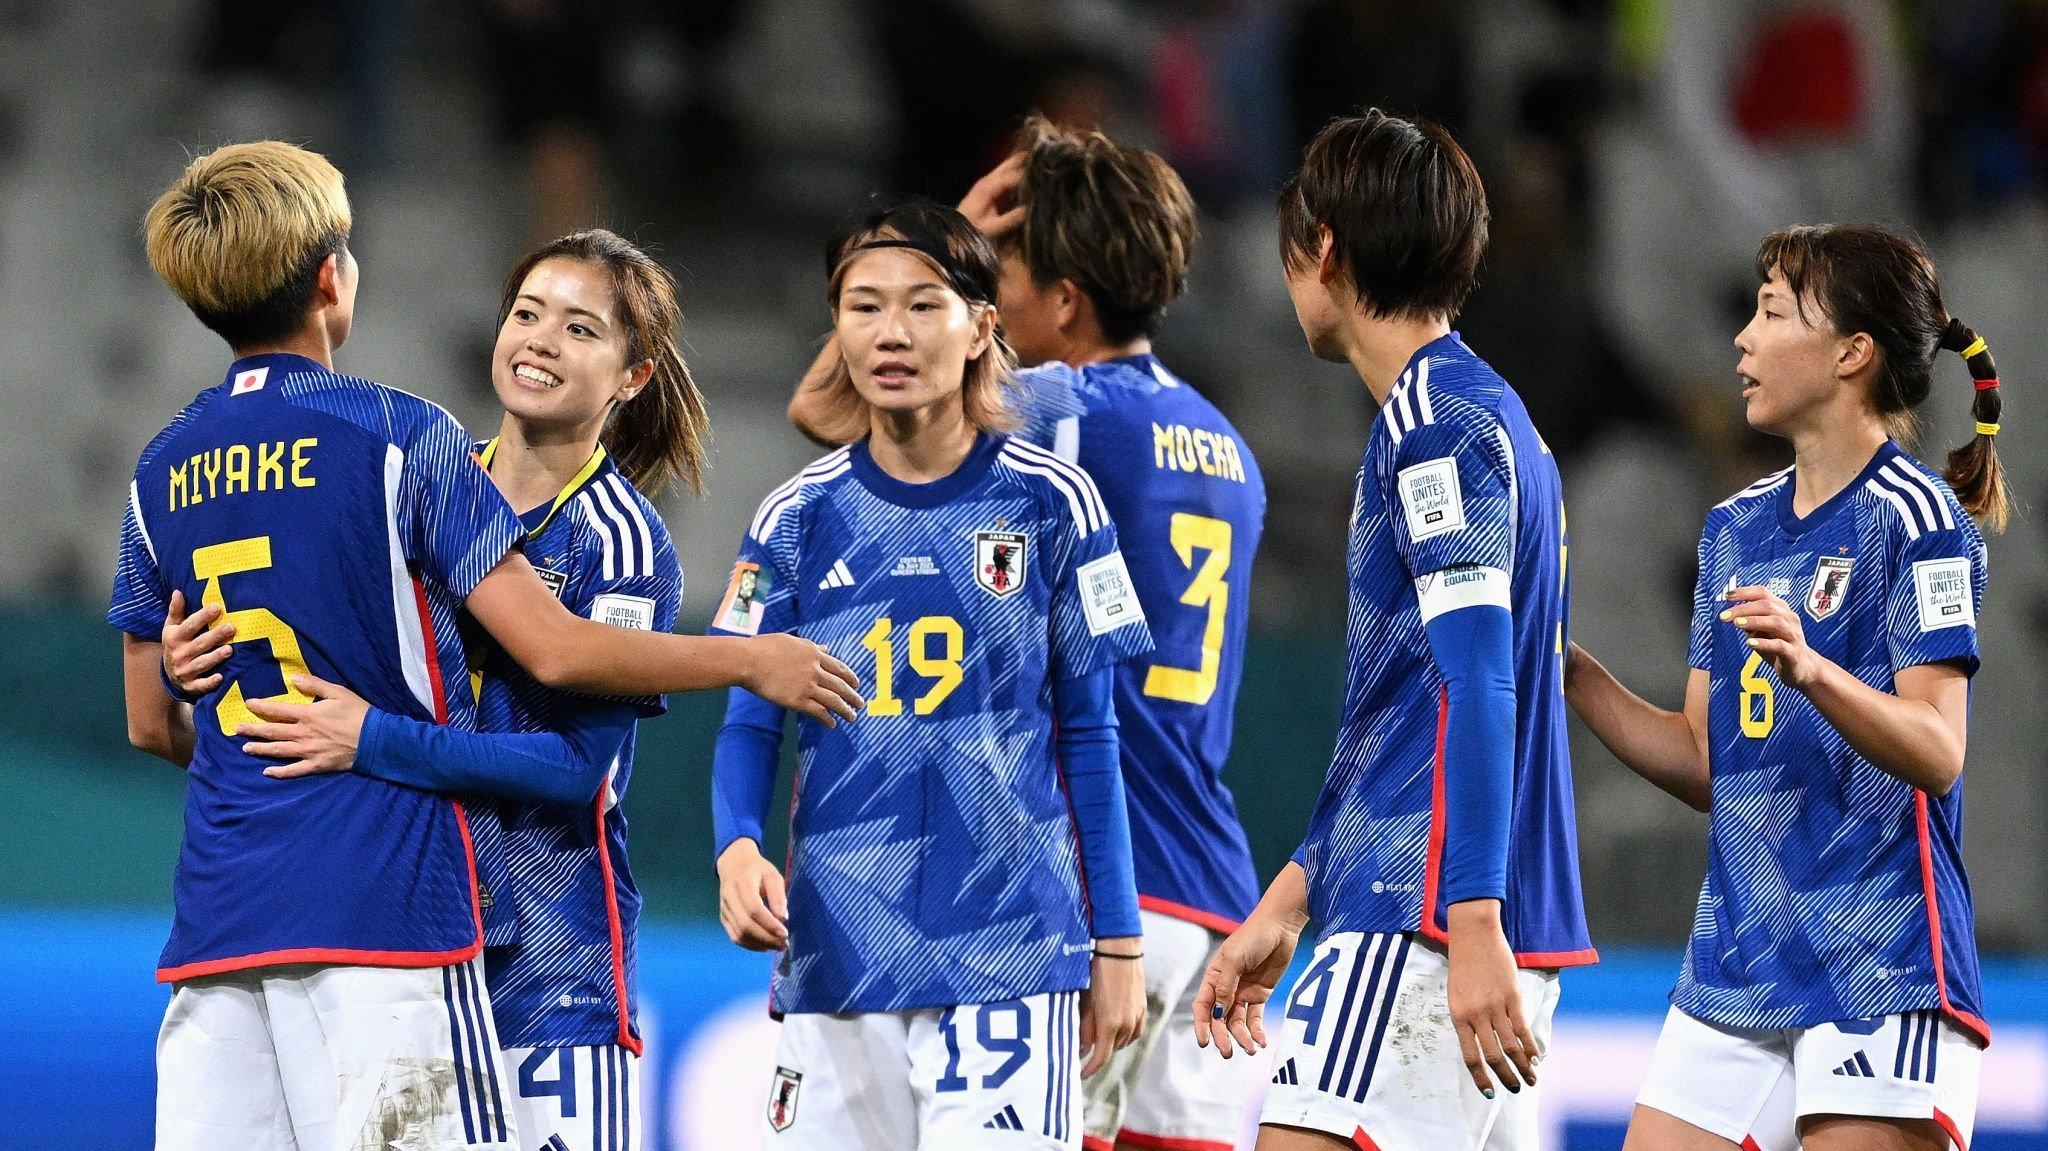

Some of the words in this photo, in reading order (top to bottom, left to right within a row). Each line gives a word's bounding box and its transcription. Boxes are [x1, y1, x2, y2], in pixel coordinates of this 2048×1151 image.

[1152, 421, 1246, 484] MOEKA
[169, 438, 318, 512] MIYAKE
[1409, 472, 1444, 489] FOOTBALL
[1412, 481, 1446, 502] UNITES
[1426, 494, 1449, 511] World
[1444, 572, 1487, 587] EQUALITY
[1828, 559, 1850, 567] JAPAN
[1928, 569, 1964, 581] FOOTBALL
[1091, 575, 1124, 596] UNITES
[1930, 578, 1966, 594] UNITES
[606, 606, 643, 620] FOOTBALL
[1143, 512, 1232, 705] 3
[192, 536, 315, 737] 5
[860, 615, 964, 717] 19
[1739, 650, 1774, 738] 6
[1286, 947, 1341, 1046] 4
[936, 1000, 1031, 1093] 19
[518, 1047, 577, 1117] 4
